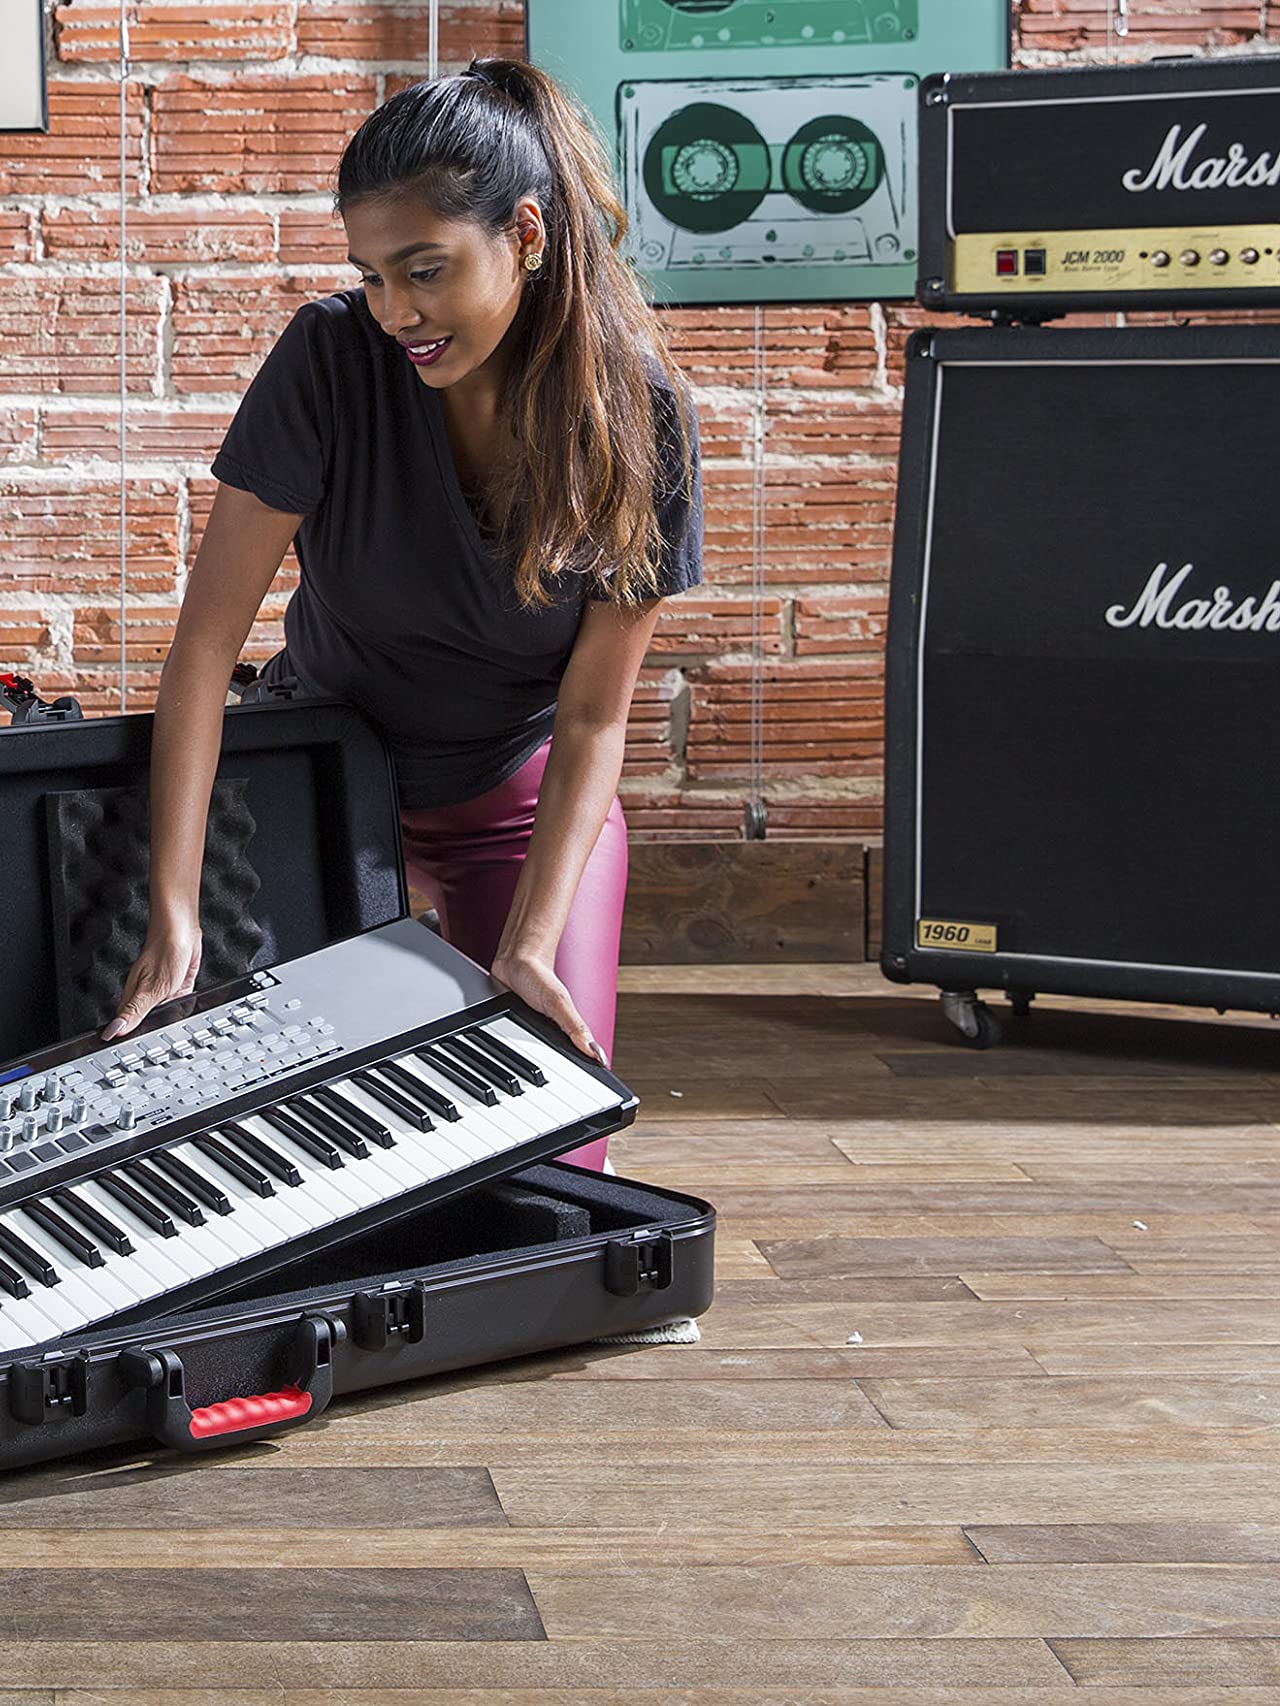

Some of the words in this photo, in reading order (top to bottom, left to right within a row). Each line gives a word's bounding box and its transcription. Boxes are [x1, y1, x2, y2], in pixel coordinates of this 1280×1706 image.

[1061, 250, 1090, 265] JCM
[1093, 249, 1125, 264] 2000
[923, 924, 970, 942] 1960
